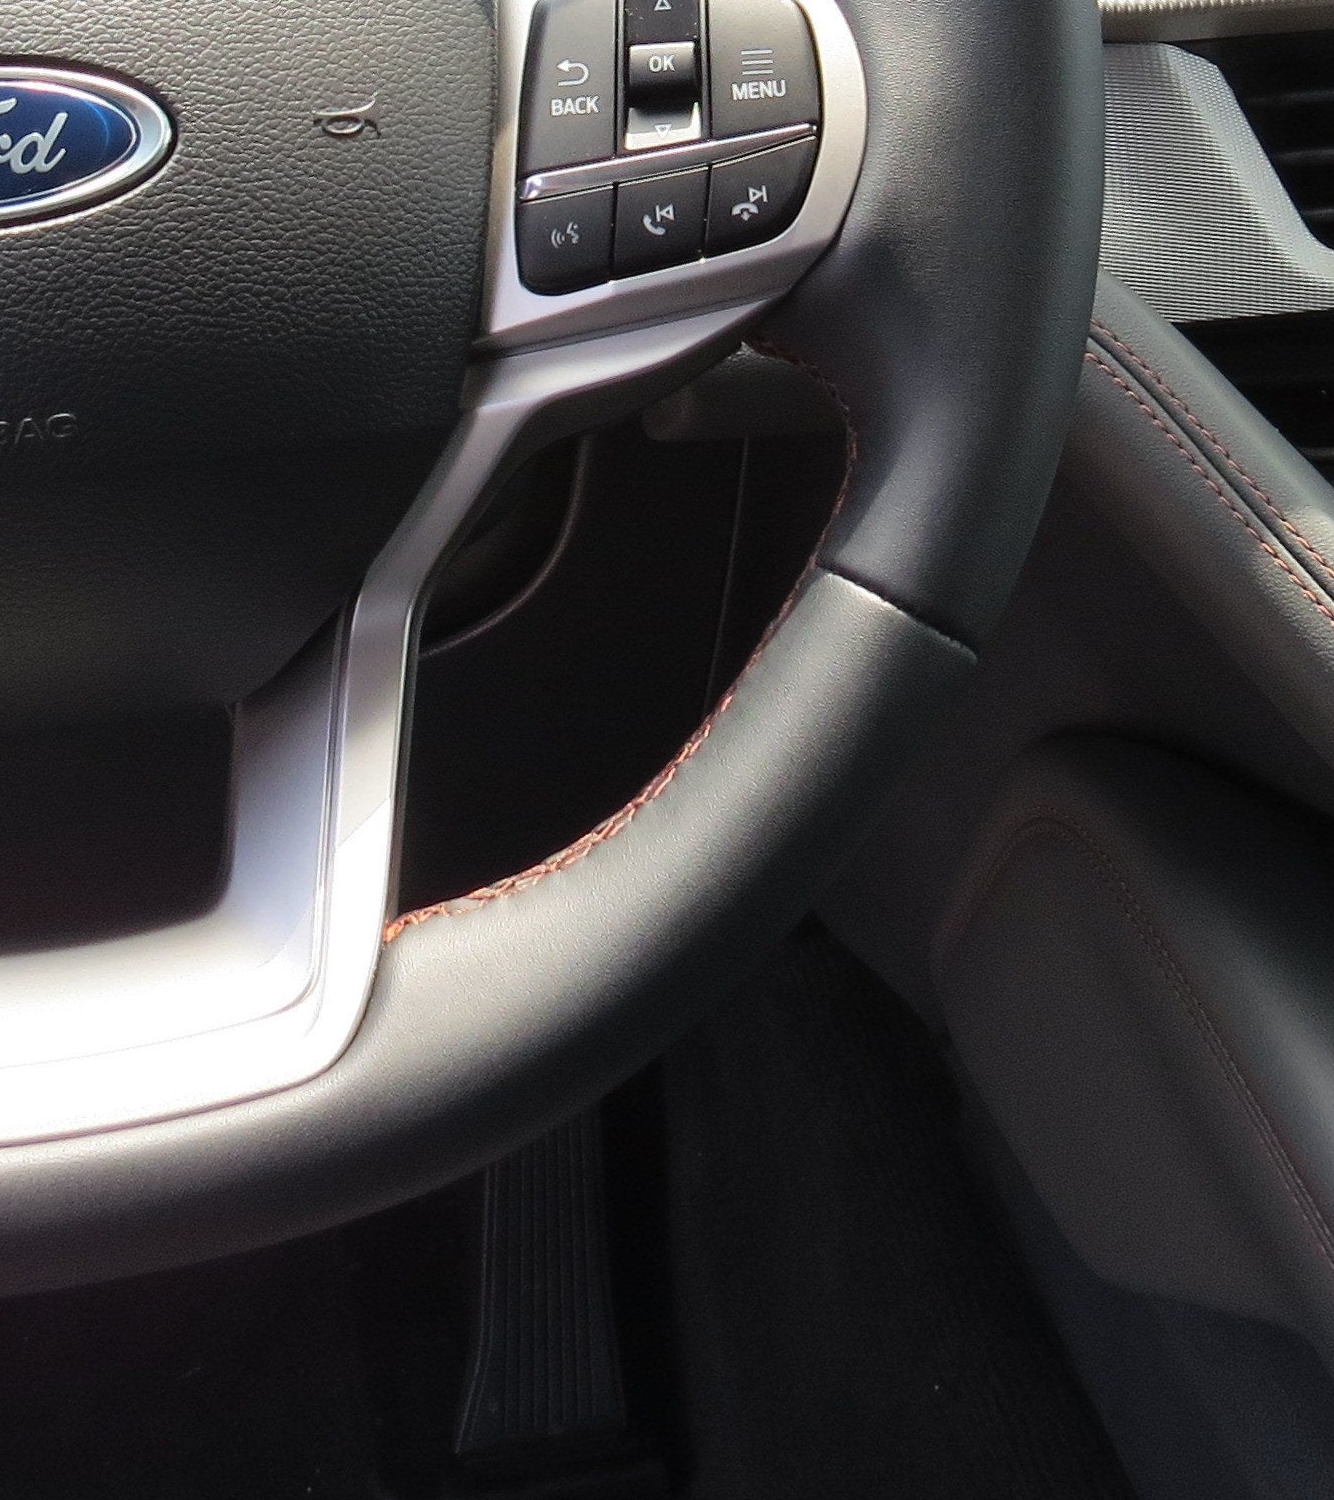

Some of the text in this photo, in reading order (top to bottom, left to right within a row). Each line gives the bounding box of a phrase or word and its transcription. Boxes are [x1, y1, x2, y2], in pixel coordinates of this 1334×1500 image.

[648, 54, 676, 72] OK
[731, 78, 787, 101] MENU
[550, 95, 600, 117] BACK
